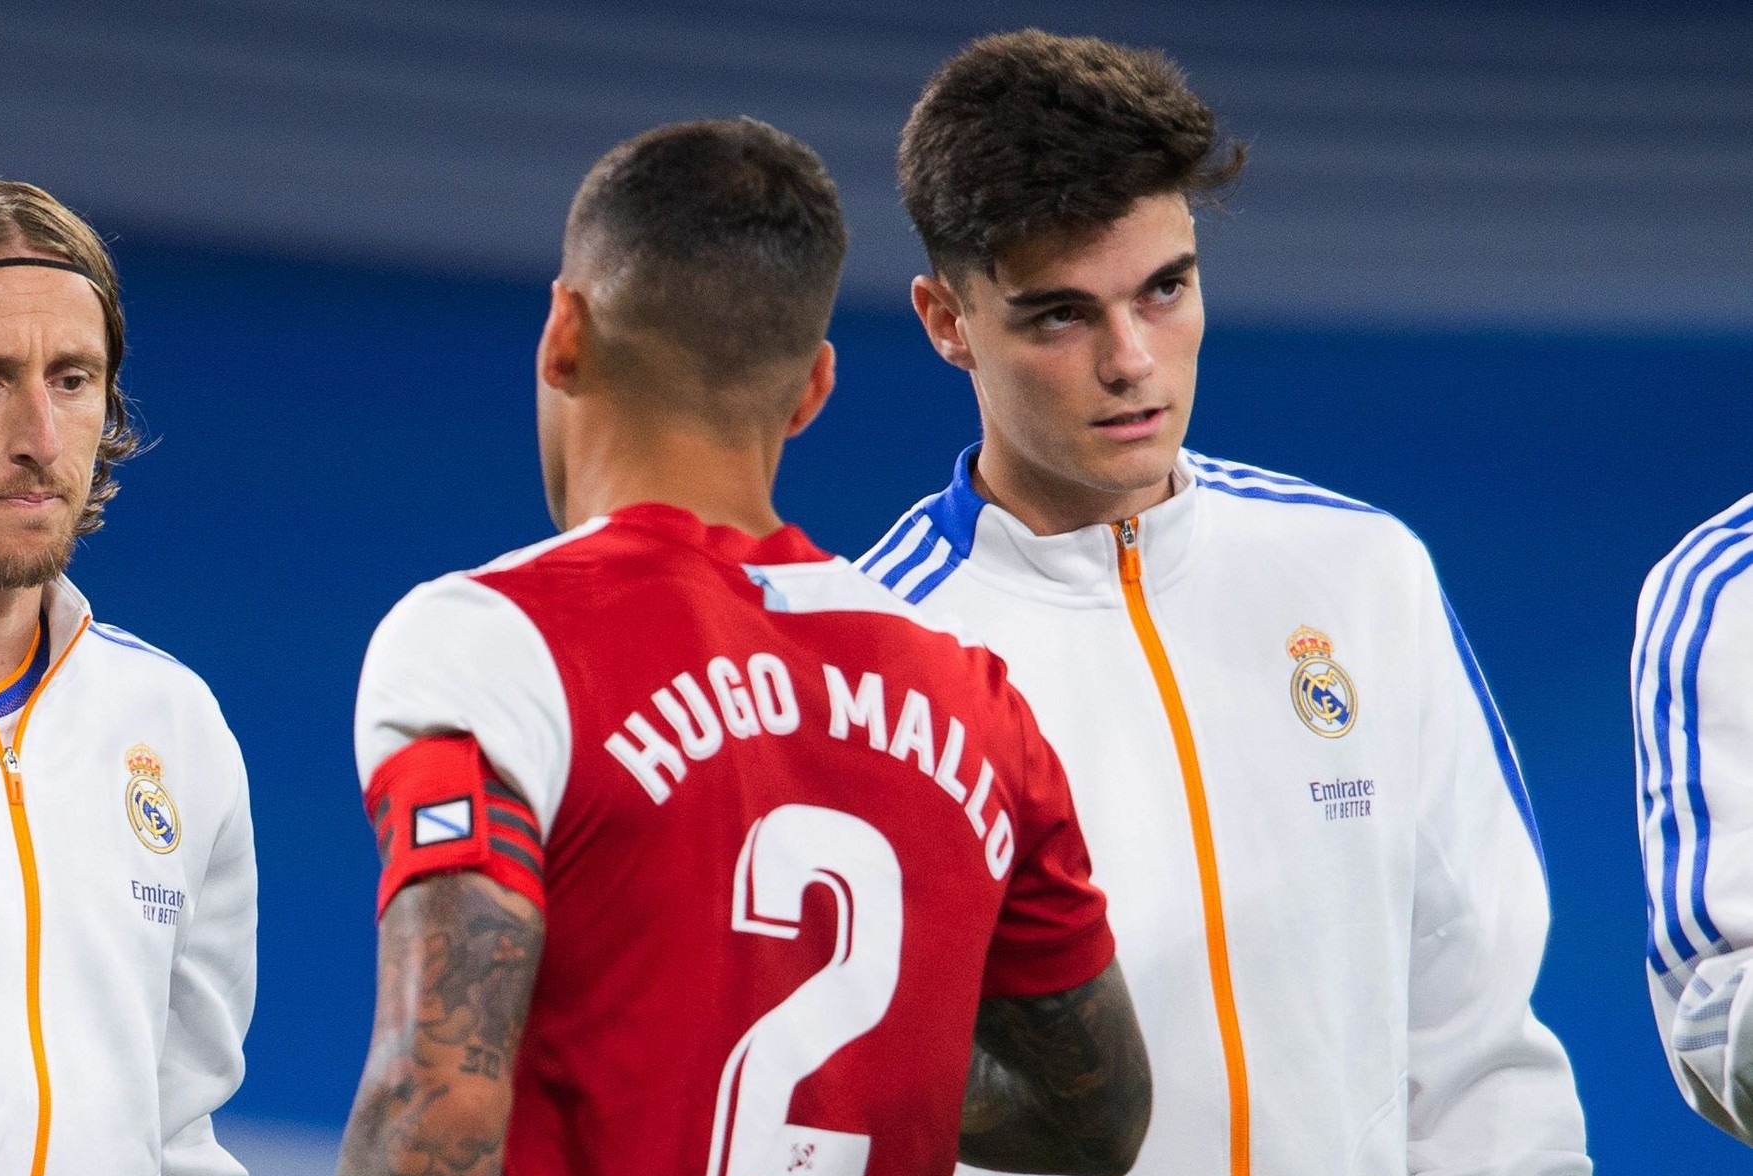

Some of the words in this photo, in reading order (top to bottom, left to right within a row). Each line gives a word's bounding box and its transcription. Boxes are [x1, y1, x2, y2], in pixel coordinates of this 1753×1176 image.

[604, 652, 801, 805] HUGO
[821, 663, 1015, 882] MALLO
[1325, 802, 1337, 821] FLY
[1339, 800, 1371, 819] BETTER
[142, 904, 156, 921] FLY
